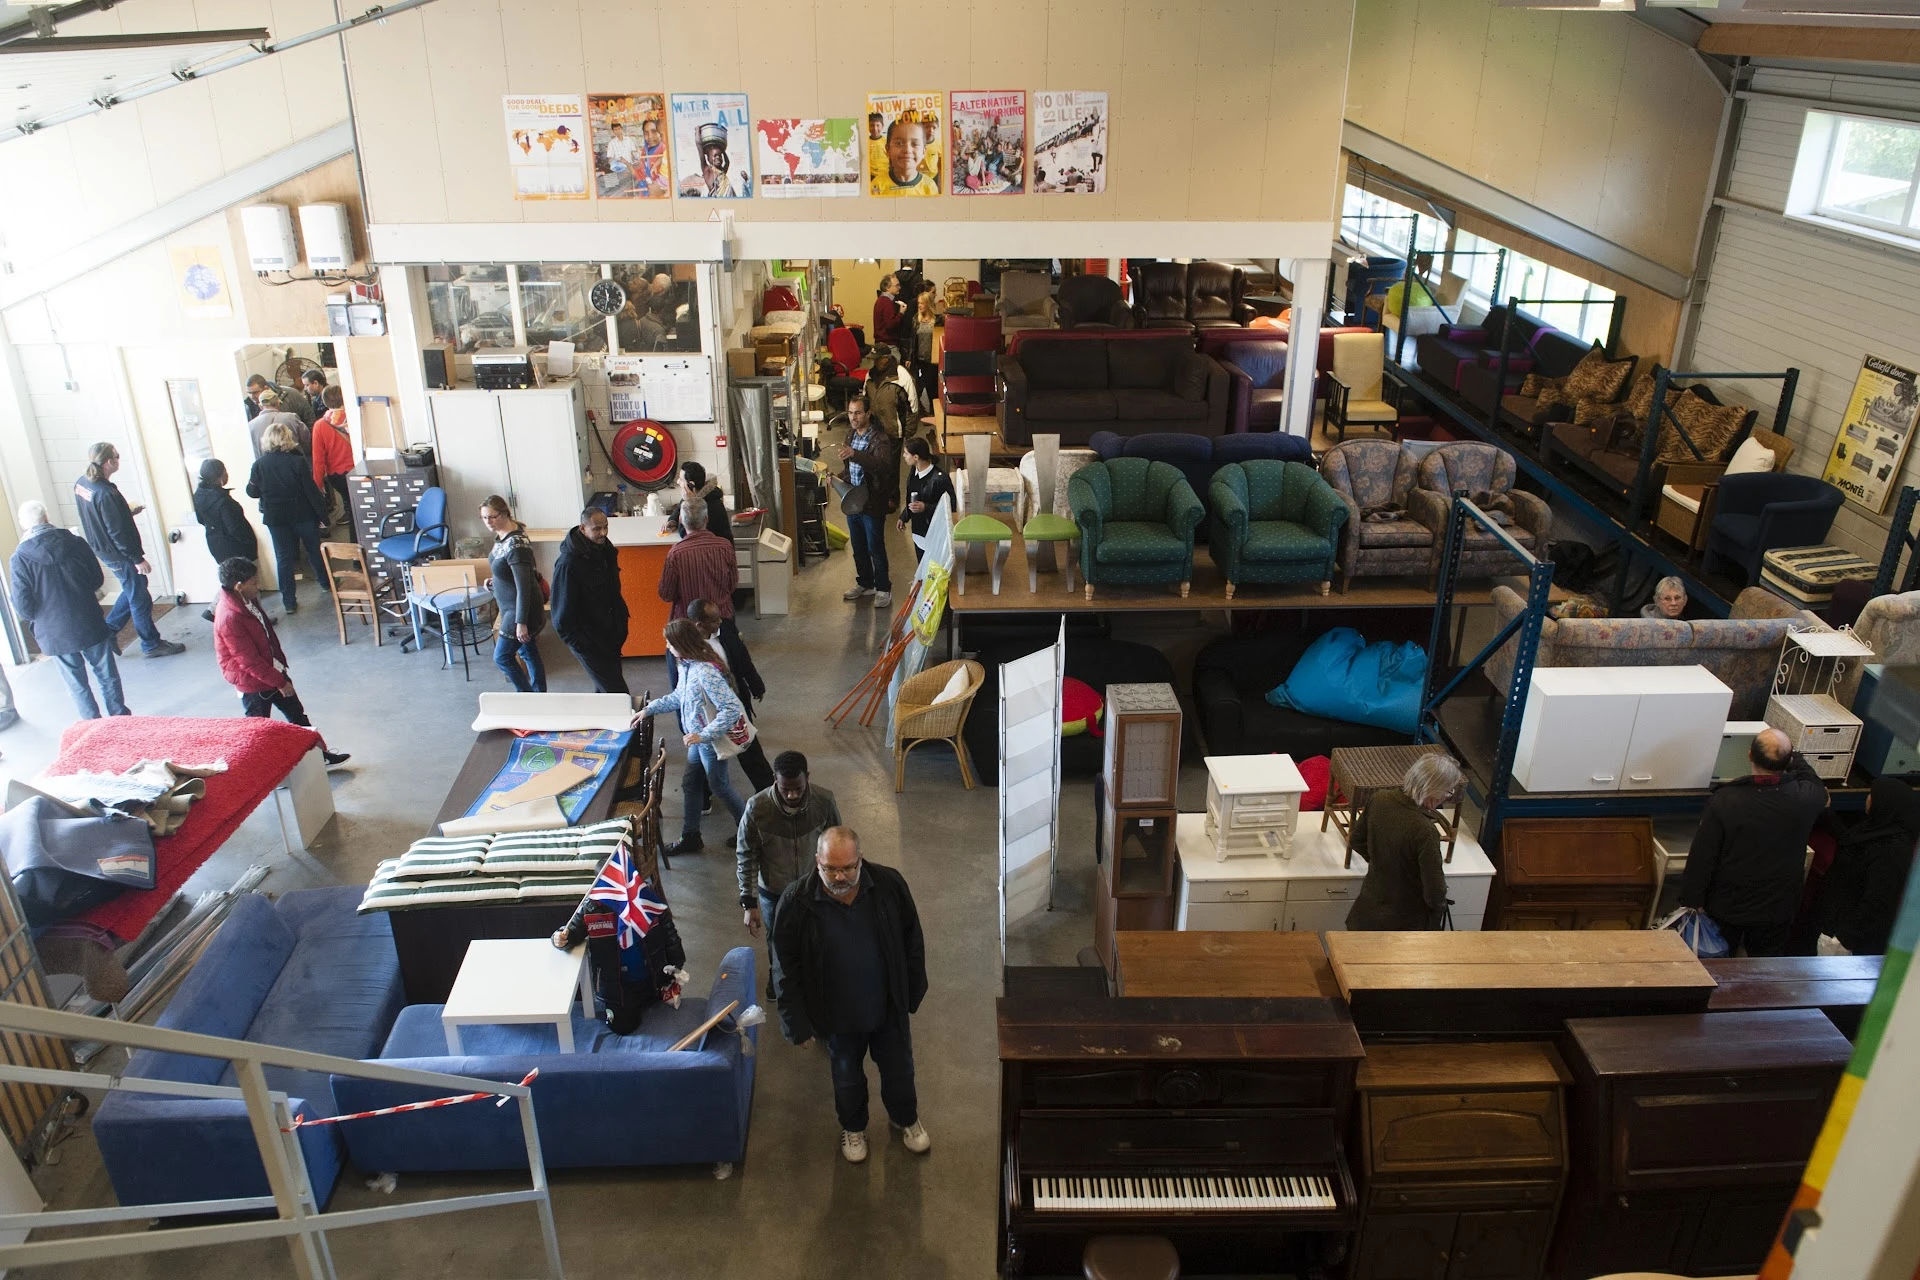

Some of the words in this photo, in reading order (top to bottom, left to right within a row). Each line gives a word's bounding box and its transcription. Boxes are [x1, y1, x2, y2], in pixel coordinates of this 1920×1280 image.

[539, 103, 579, 114] DEEDS
[673, 99, 710, 113] WATER
[867, 95, 941, 114] KNOWLEDGE
[960, 95, 1019, 111] ALTERNATIVE
[1035, 95, 1053, 109] NO
[1056, 93, 1083, 107] ONE
[717, 108, 749, 129] ALL
[895, 109, 937, 125] POWER
[983, 106, 1025, 119] WORKING
[1868, 357, 1891, 374] Geliefd
[613, 401, 633, 410] KUNT
[634, 401, 640, 410] U
[614, 410, 642, 420] PINNEN
